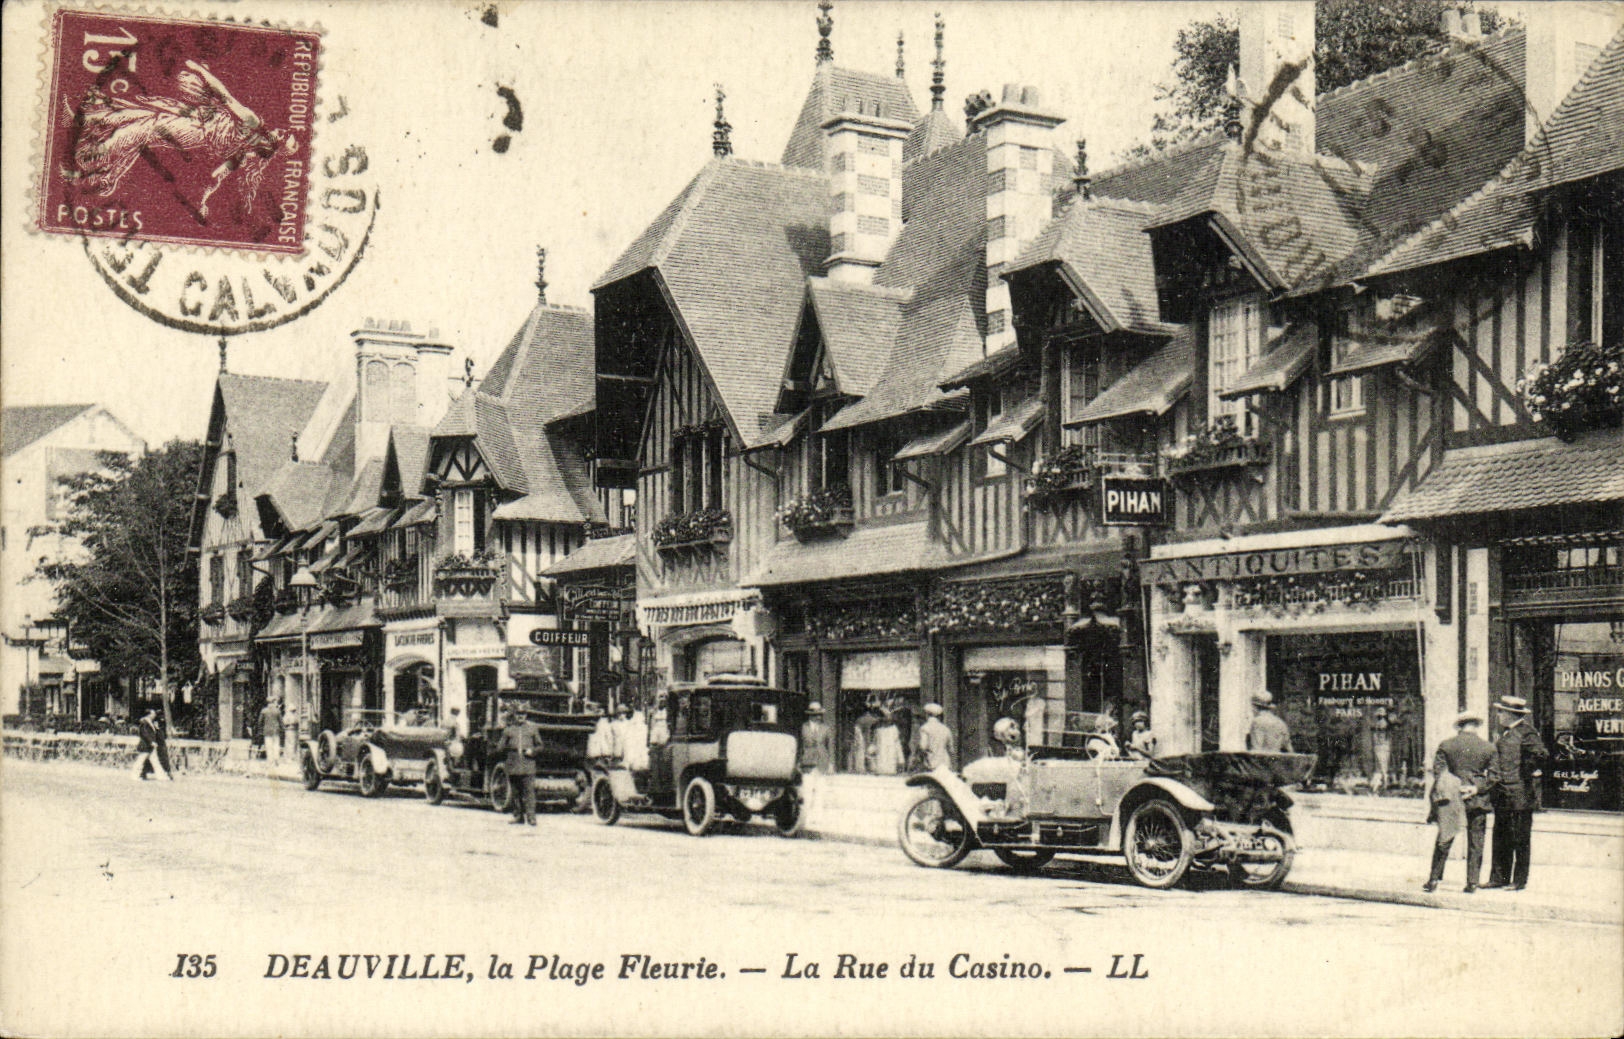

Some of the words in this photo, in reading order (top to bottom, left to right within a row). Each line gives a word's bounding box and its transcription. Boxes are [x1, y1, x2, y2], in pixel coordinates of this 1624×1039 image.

[56, 204, 144, 230] POSTES
[1107, 490, 1162, 514] PIHAN
[534, 631, 588, 643] COIFFEUR
[1319, 672, 1382, 691] PIHAN
[1561, 670, 1612, 688] PIANOS
[1577, 698, 1622, 712] AGENCE
